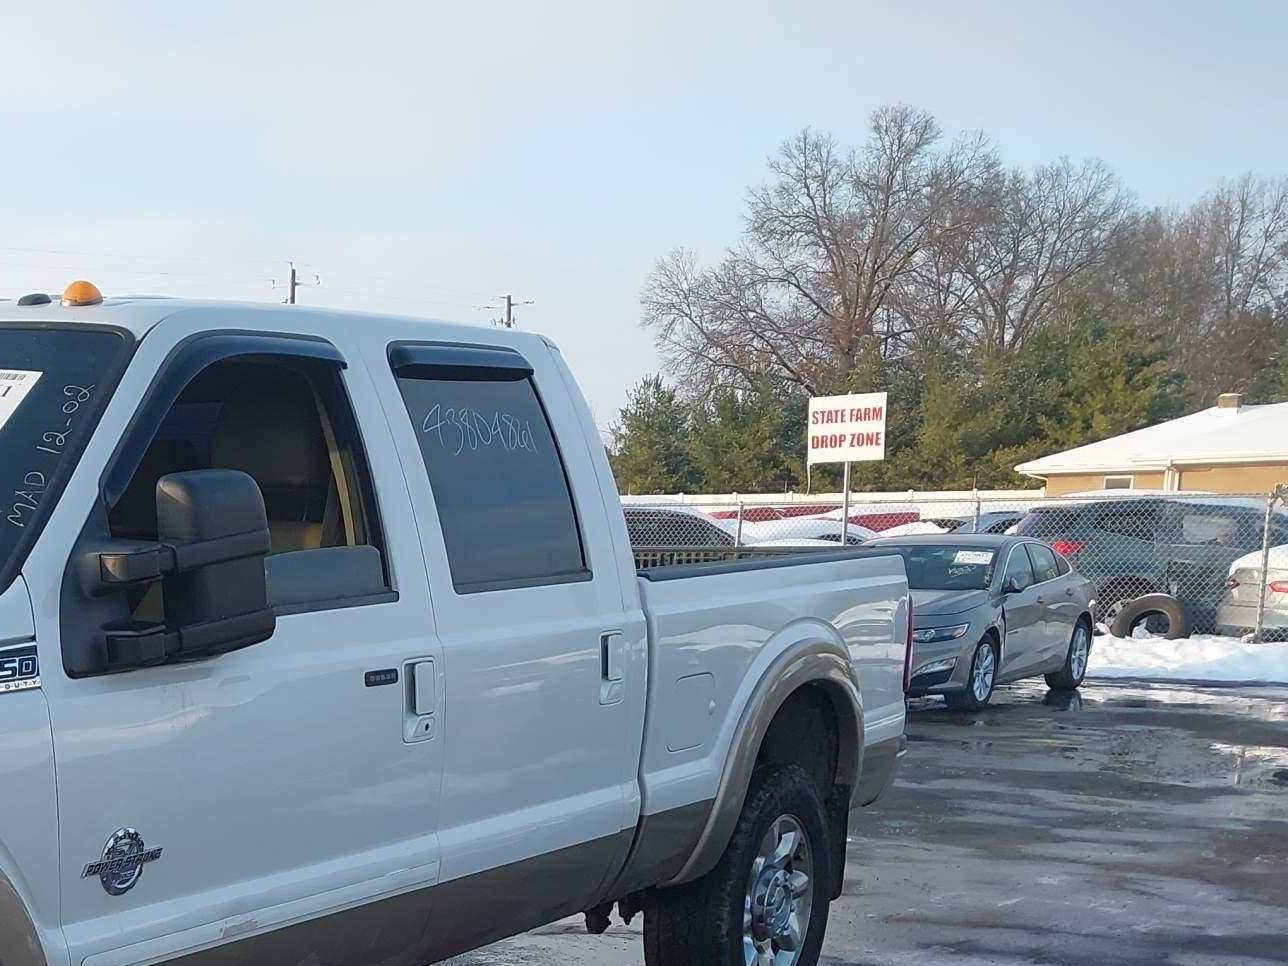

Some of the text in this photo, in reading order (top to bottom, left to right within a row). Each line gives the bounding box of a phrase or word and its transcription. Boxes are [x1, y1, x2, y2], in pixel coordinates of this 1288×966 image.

[812, 406, 883, 425] STATE FARM
[811, 431, 882, 449] DROP ZONE
[7, 470, 47, 528] MAD
[4, 680, 38, 691] DUTY
[86, 859, 123, 876] POWER
